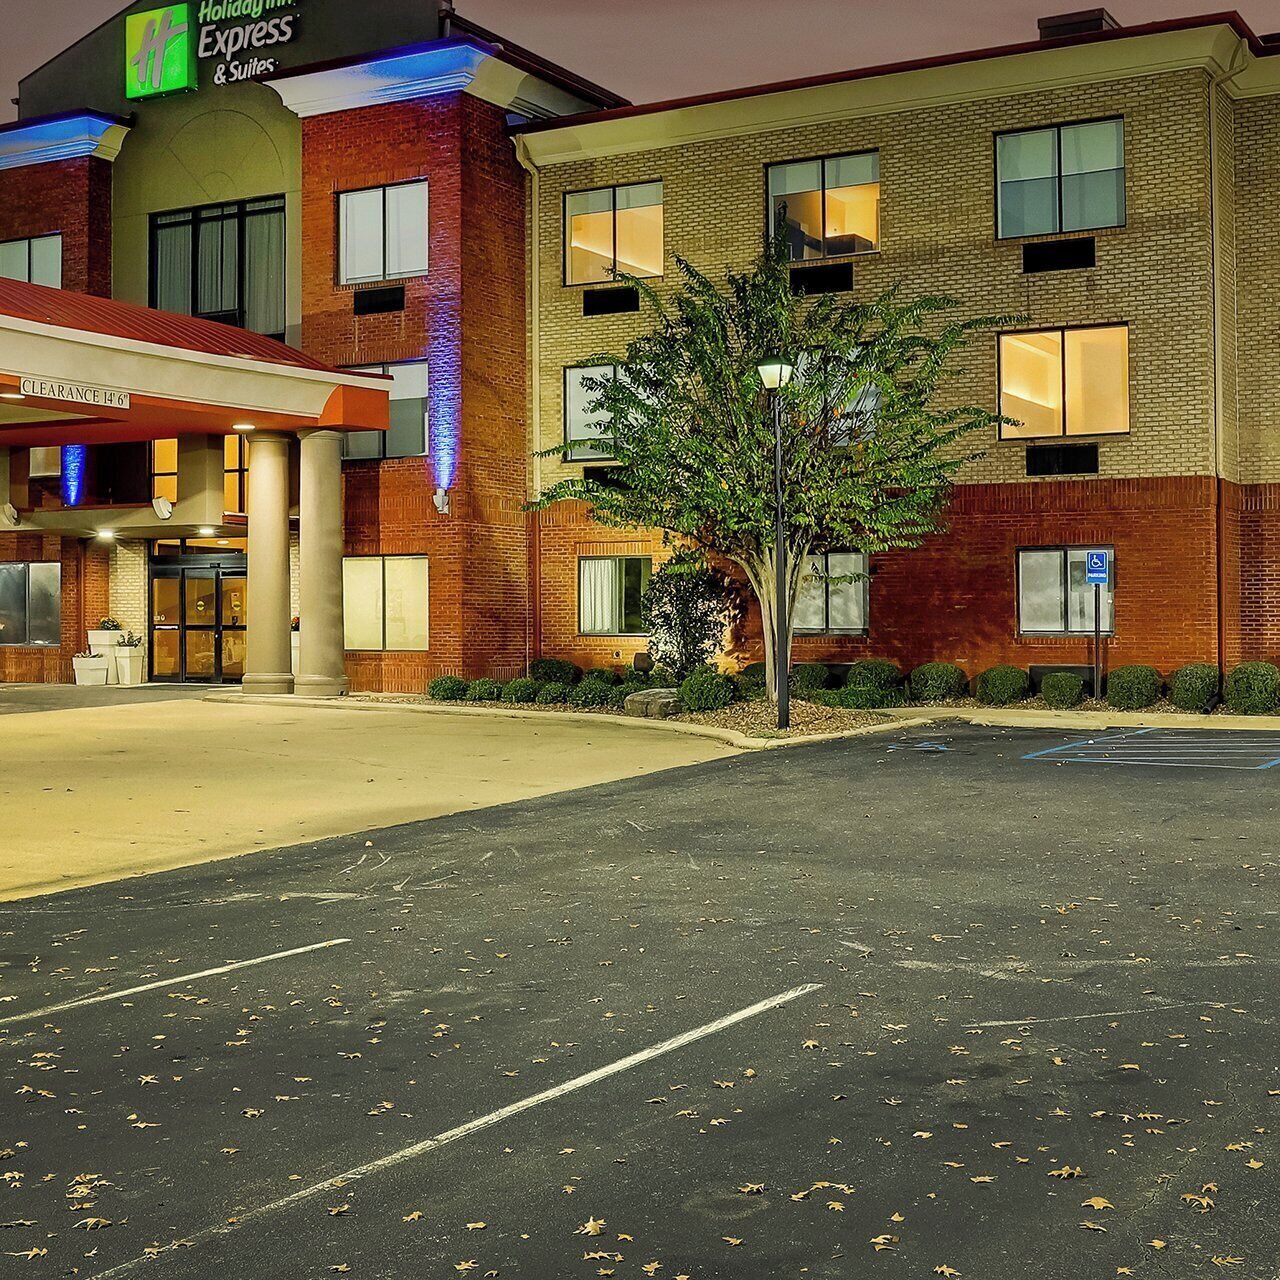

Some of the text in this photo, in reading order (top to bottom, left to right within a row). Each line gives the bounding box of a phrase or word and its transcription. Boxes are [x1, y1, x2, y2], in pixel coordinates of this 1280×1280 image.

[198, 15, 293, 62] Express
[213, 57, 275, 85] & Suites
[22, 379, 100, 403] CLEARANCE
